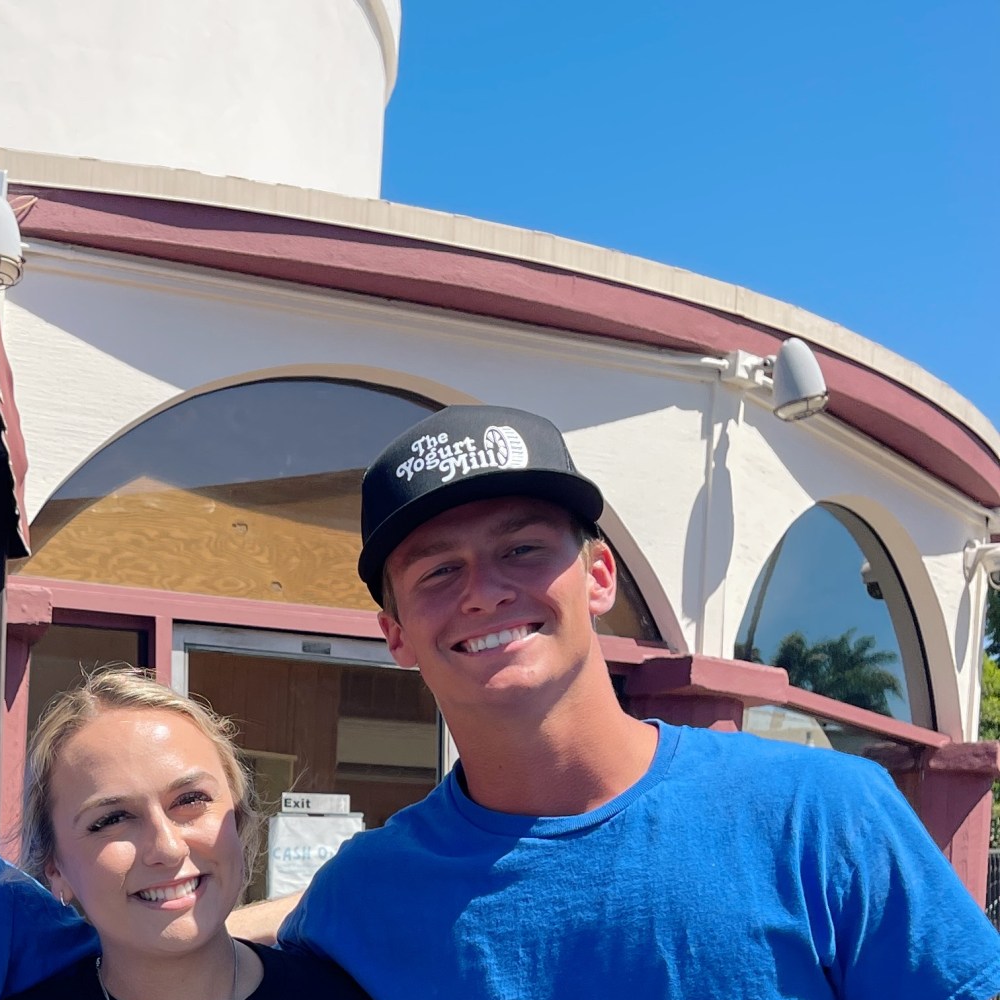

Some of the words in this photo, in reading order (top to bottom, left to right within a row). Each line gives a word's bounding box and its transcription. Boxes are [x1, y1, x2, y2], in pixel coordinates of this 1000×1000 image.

[411, 432, 449, 457] The
[395, 436, 478, 482] Yogurt
[438, 449, 499, 483] Mill
[284, 798, 311, 809] Exit
[272, 846, 312, 861] CASH
